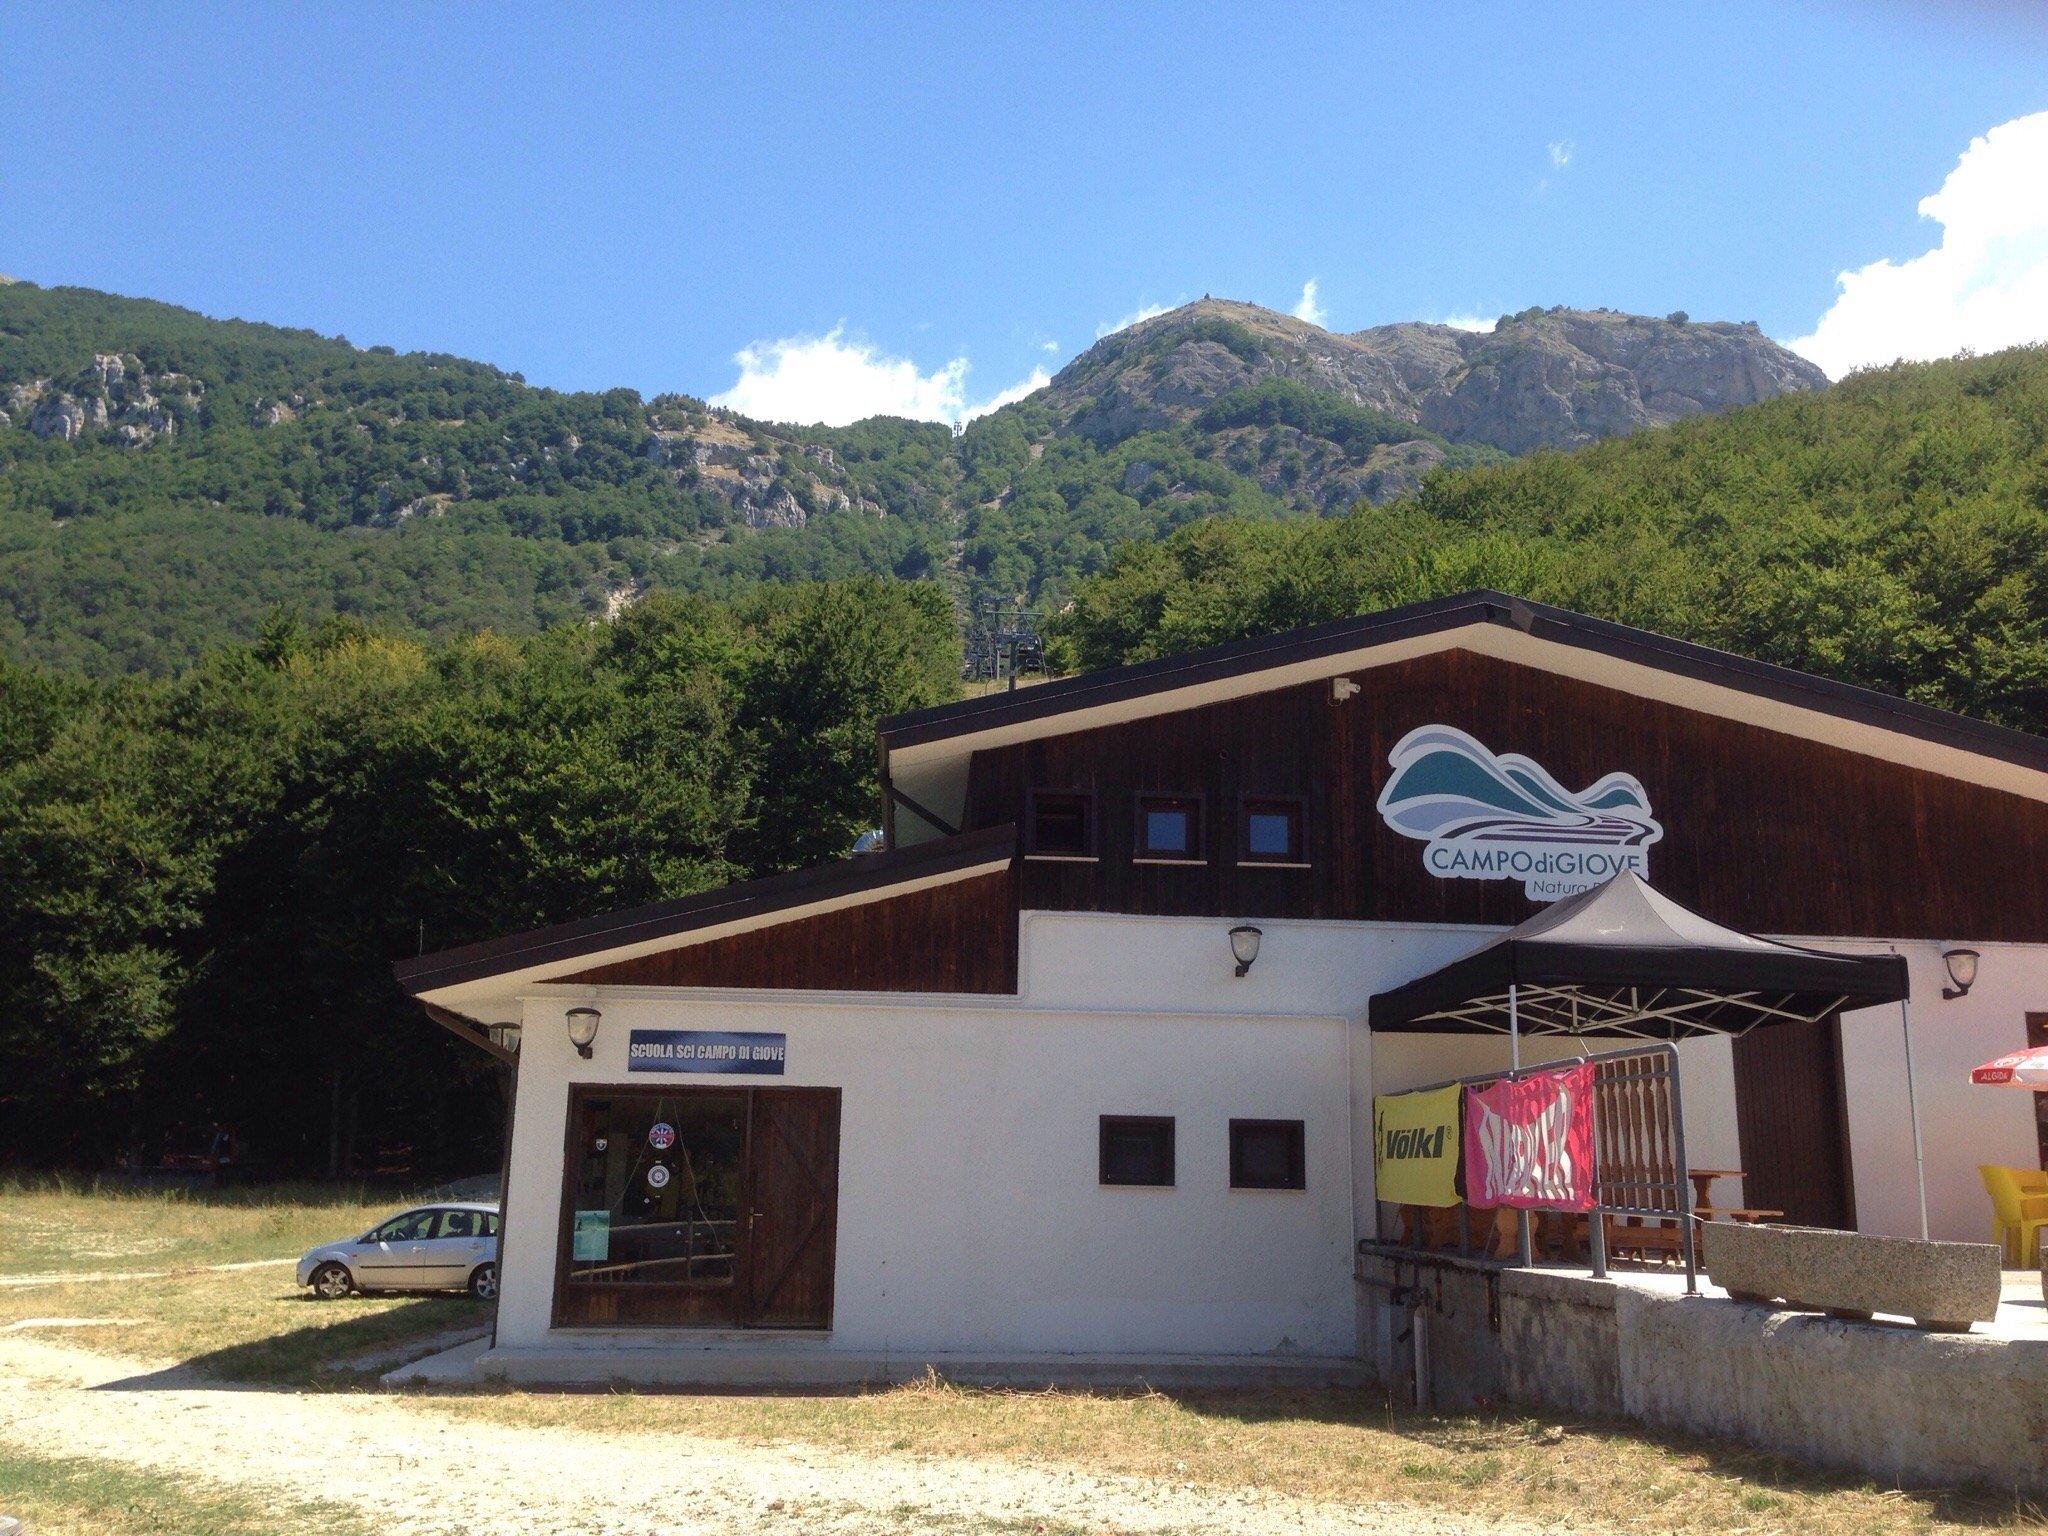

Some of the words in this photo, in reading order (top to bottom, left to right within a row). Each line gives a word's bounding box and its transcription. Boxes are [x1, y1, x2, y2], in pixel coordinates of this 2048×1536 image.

[1533, 881, 1587, 894] Natura
[631, 1044, 674, 1058] SCUOLA
[676, 1044, 695, 1058] SCI
[697, 1045, 736, 1060] CAMPO
[738, 1046, 750, 1060] DI
[752, 1046, 784, 1061] GIOVE
[1386, 1125, 1445, 1159] Völkl
